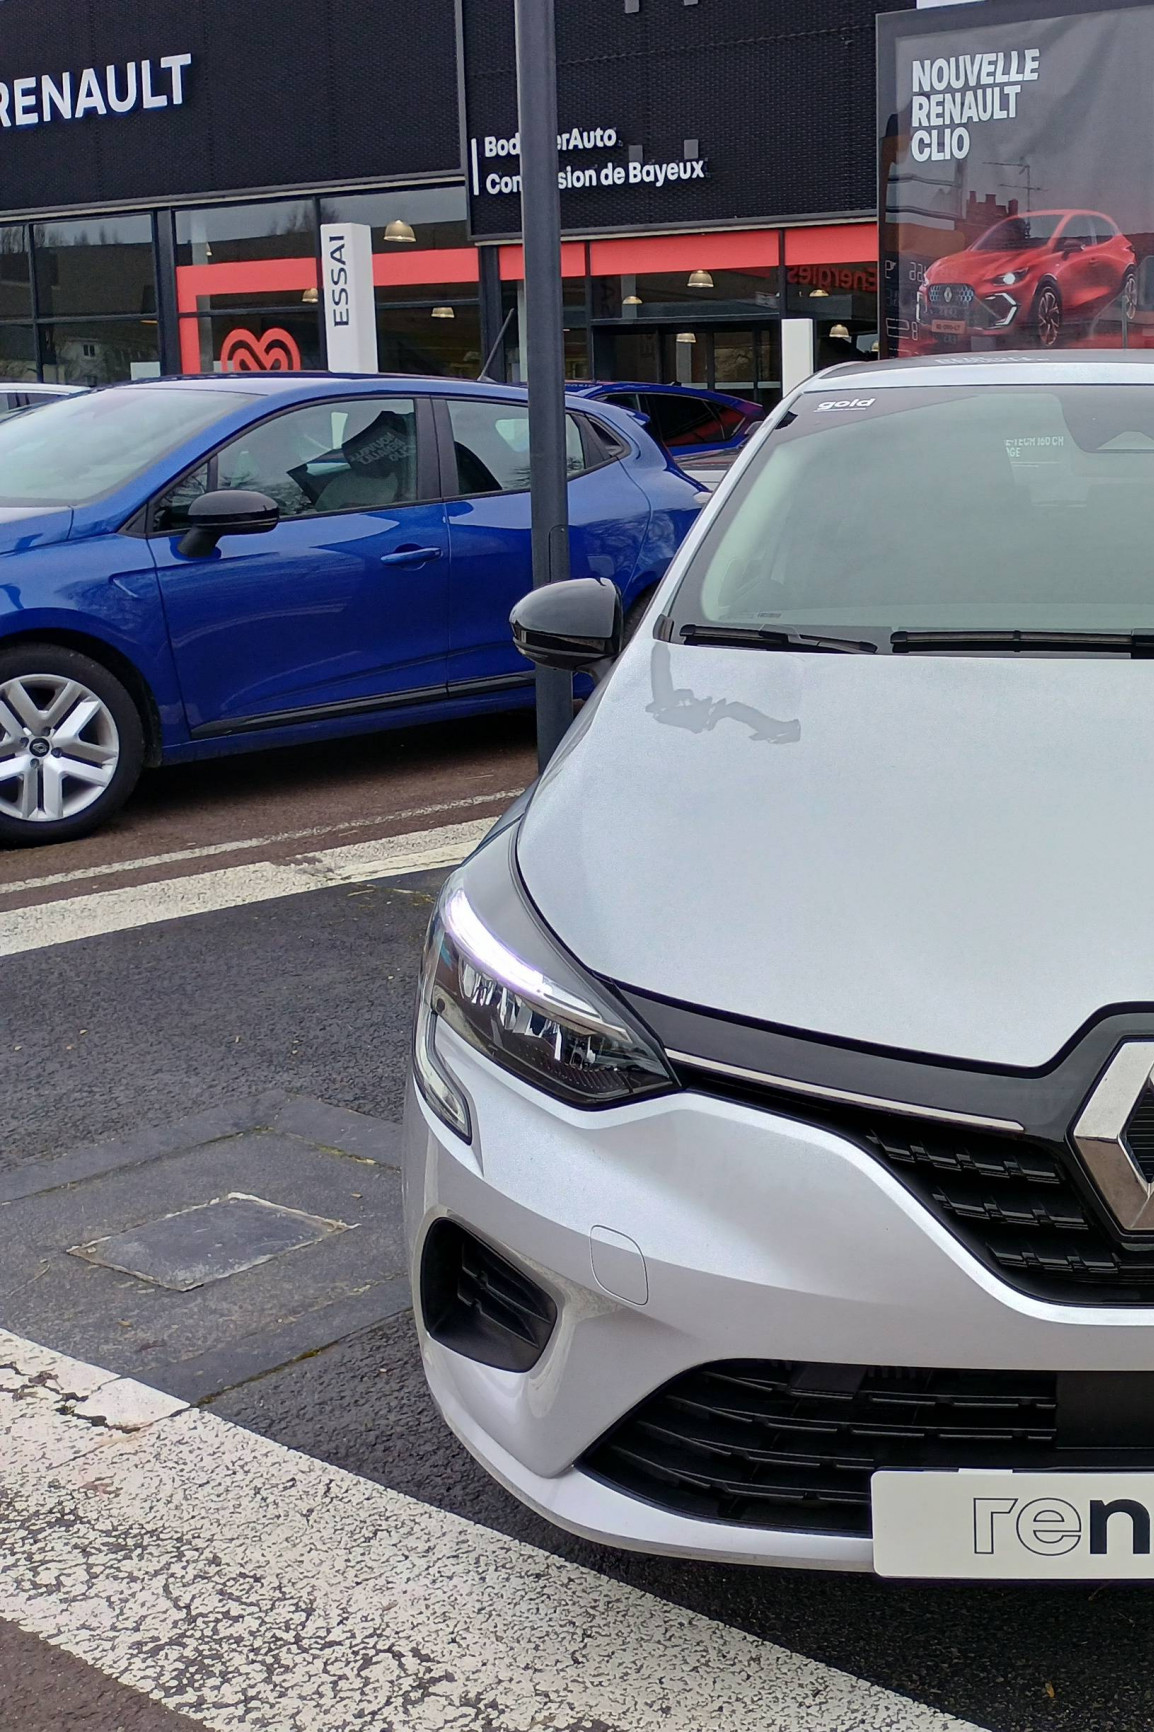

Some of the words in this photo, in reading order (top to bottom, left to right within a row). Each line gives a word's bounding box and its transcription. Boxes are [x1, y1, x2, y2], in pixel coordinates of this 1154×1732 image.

[912, 48, 1040, 93] NOUVELLE
[911, 85, 1021, 127] RENAULT
[484, 127, 617, 157] BodrAuto
[911, 126, 970, 162] CLIO
[485, 166, 597, 194] Consion
[600, 162, 626, 186] de
[628, 160, 705, 187] Bayeux
[329, 235, 349, 327] ESSAI
[817, 398, 876, 411] gold
